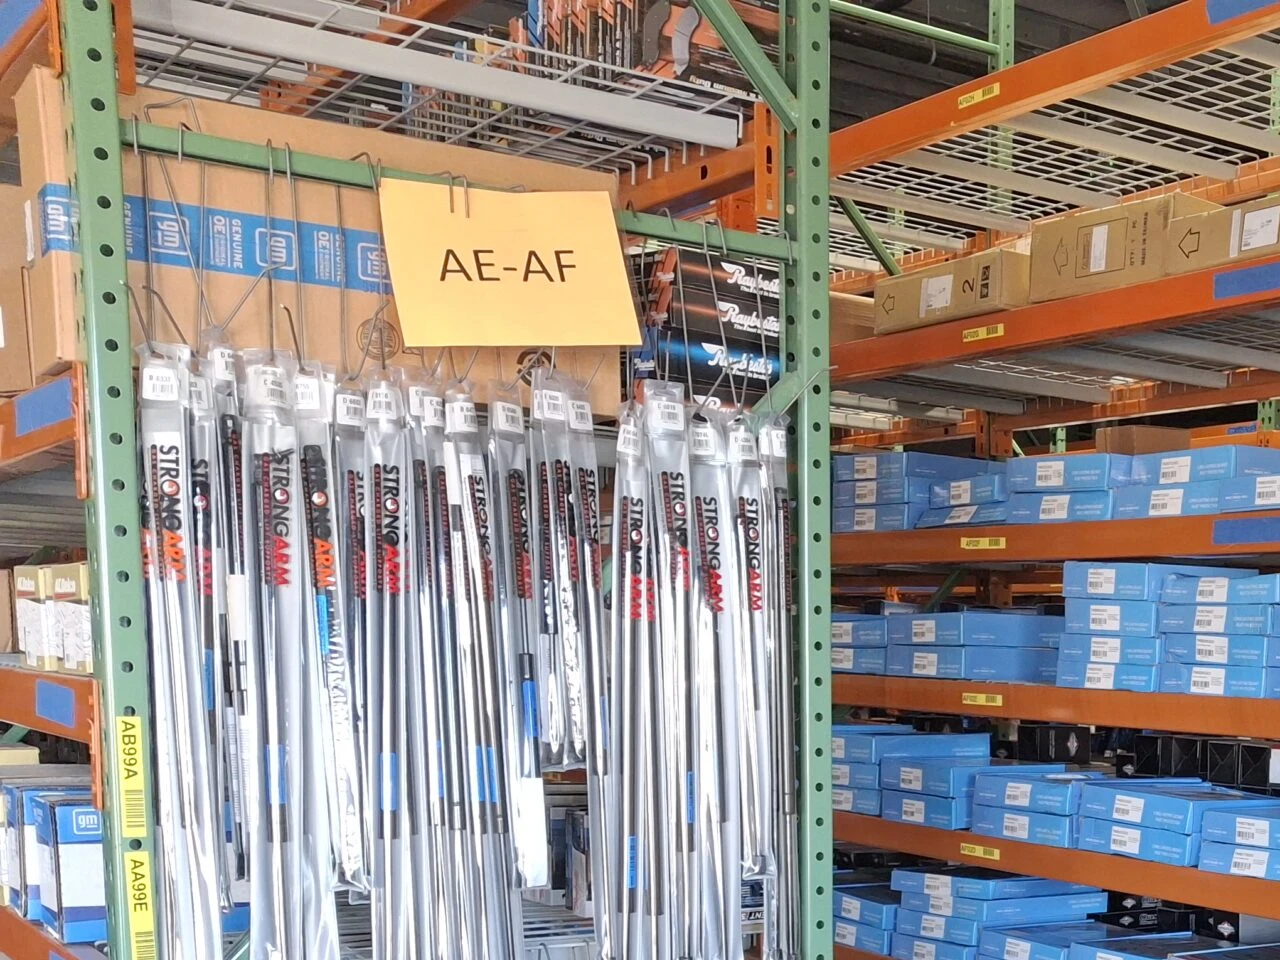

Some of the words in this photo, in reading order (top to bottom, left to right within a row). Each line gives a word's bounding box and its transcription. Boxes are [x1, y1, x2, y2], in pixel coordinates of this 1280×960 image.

[157, 220, 181, 249] gm
[232, 218, 243, 269] GENUINE
[270, 237, 286, 263] gm
[439, 248, 576, 283] AE-AF
[720, 261, 780, 293] Raybest
[962, 277, 975, 293] 2
[159, 444, 186, 583] STRONGARM
[271, 449, 293, 586] STRONGARM
[383, 463, 401, 594] STRONGARM
[702, 496, 724, 614] STRONGARM
[745, 497, 763, 612] STRONGARM
[121, 720, 138, 781] AB99A
[78, 814, 98, 829] gm
[130, 857, 148, 913] AA99E
